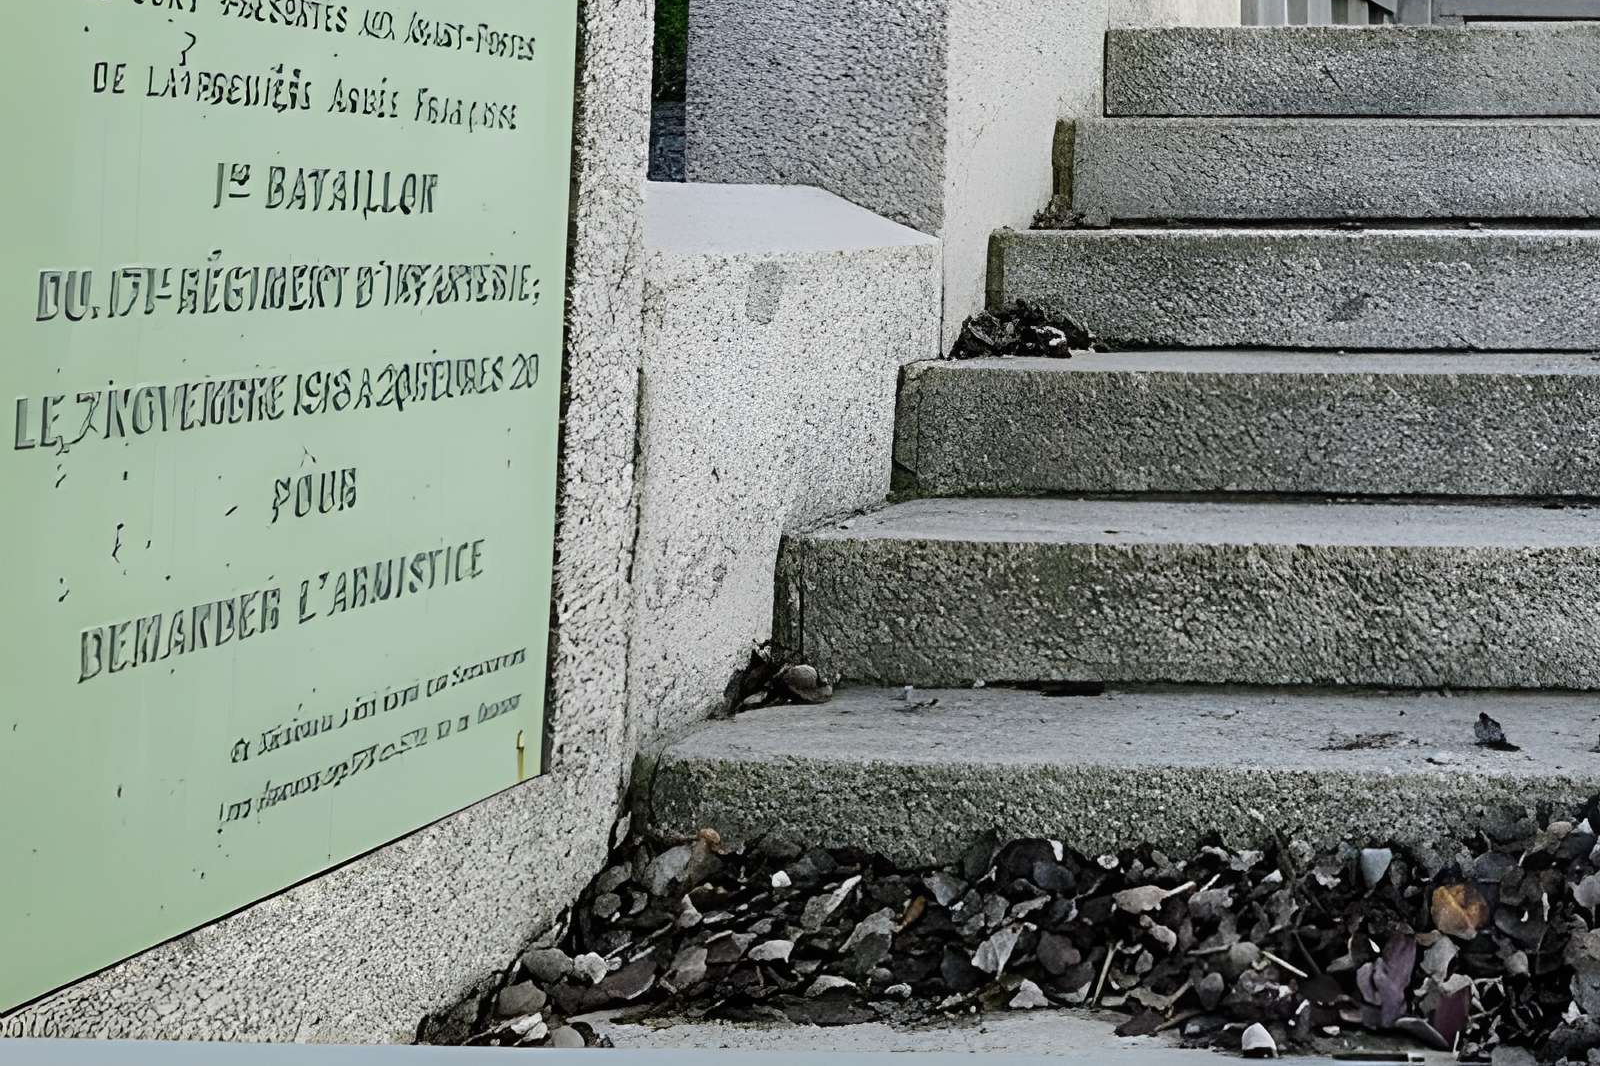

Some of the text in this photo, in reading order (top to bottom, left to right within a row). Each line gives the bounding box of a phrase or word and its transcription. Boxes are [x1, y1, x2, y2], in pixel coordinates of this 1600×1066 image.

[93, 62, 127, 94] DE
[265, 165, 439, 220] BATAILLON
[14, 396, 65, 449] LE
[510, 353, 540, 391] 20
[271, 467, 358, 524] POUR
[77, 538, 486, 683] DEMANDER L'ARMISTICE
